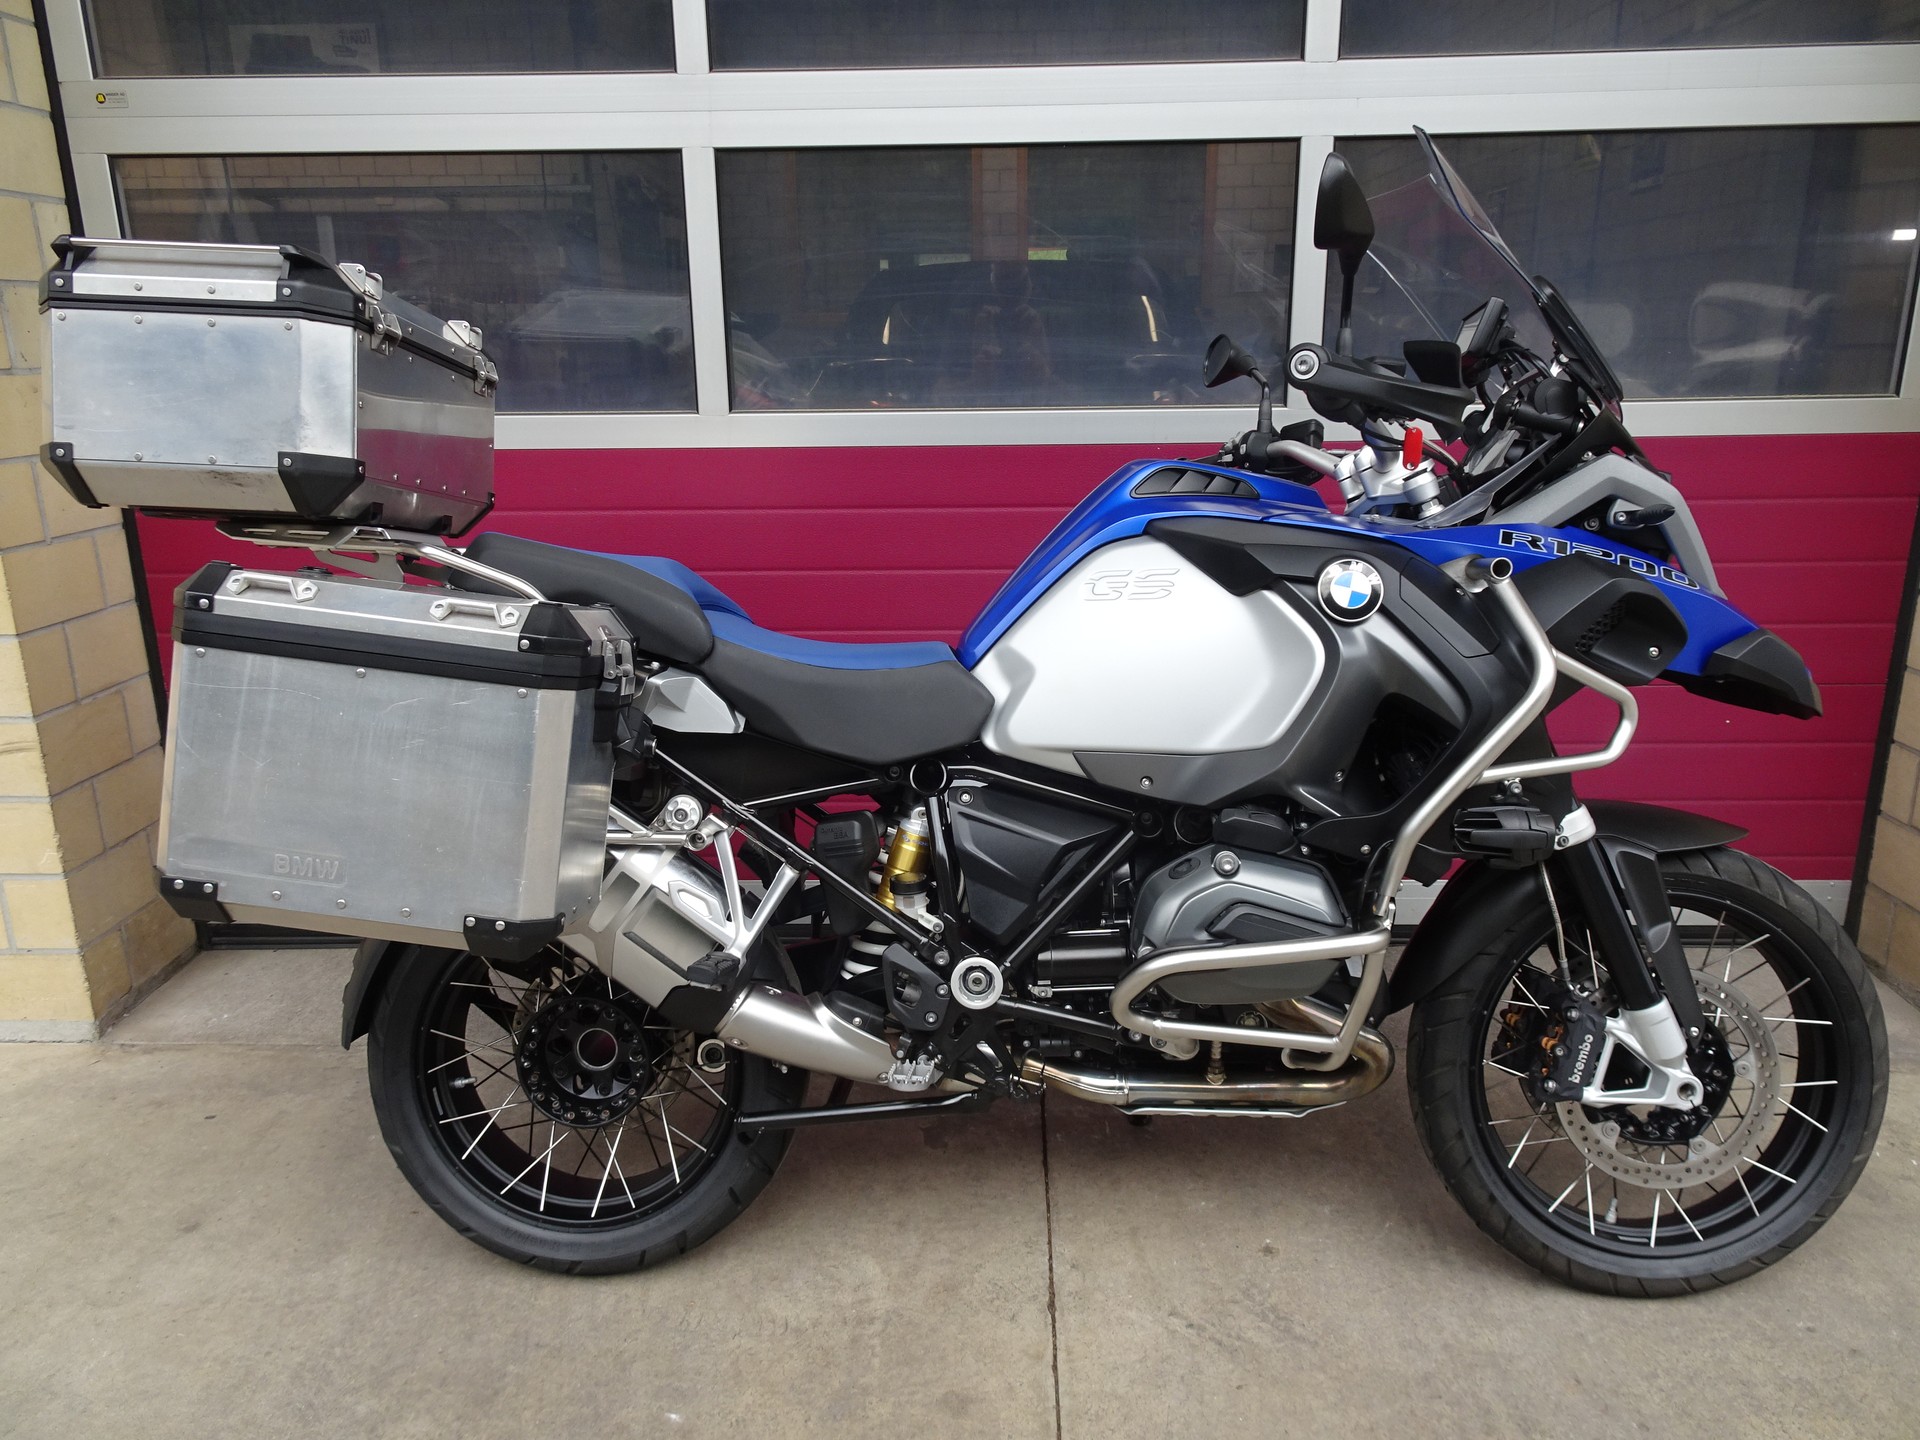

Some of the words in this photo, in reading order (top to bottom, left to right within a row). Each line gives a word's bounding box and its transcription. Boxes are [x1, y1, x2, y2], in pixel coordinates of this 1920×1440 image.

[1322, 560, 1381, 585] BMW
[1499, 529, 1700, 590] R1200
[1084, 568, 1180, 601] GS
[273, 853, 339, 880] BMW
[1568, 1034, 1594, 1084] brembo
